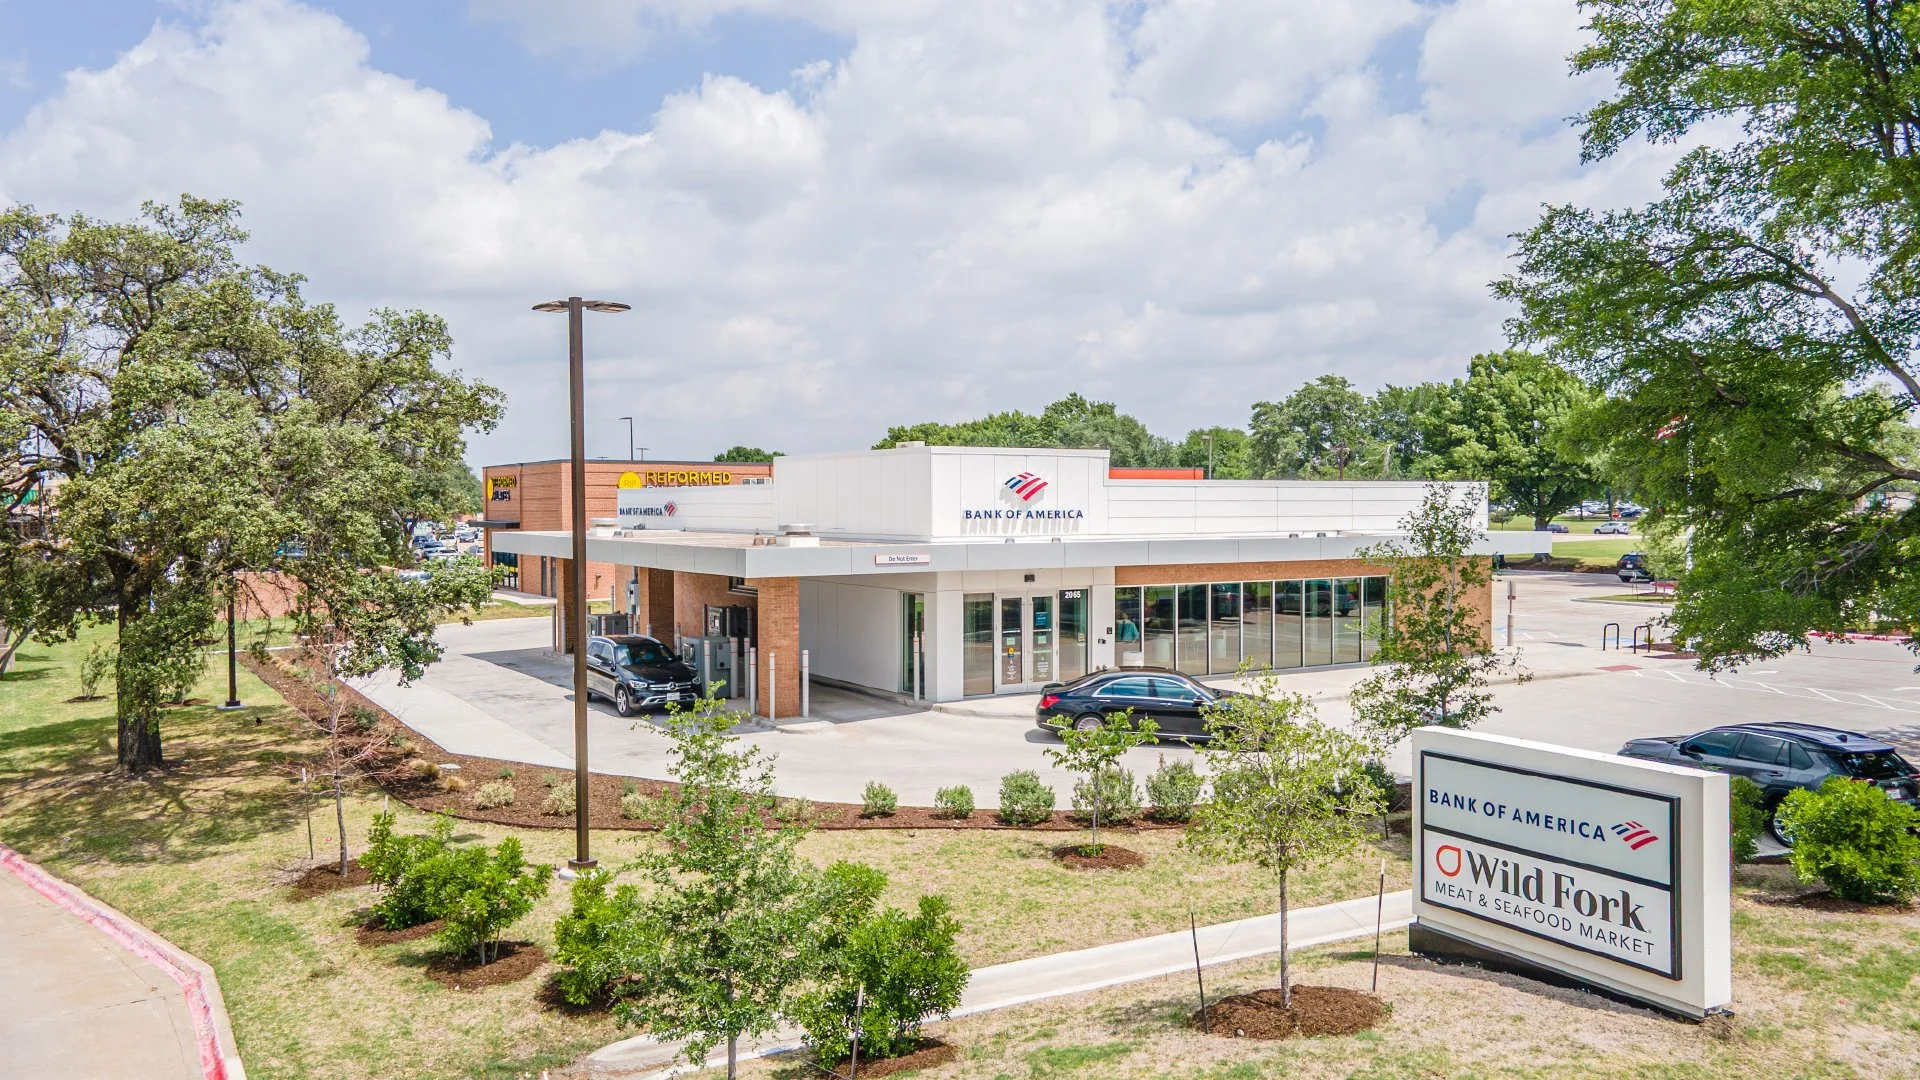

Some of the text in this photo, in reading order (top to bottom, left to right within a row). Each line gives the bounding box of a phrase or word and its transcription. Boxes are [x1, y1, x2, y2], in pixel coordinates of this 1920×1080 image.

[645, 471, 732, 485] REFORMED
[619, 507, 633, 516] BANK
[639, 507, 663, 516] AMERICA
[965, 509, 1084, 519] BANK OF AMERICA
[1064, 591, 1081, 599] 2065
[1429, 789, 1606, 842] BANK OF AMERICA
[1465, 850, 1649, 933] Wild Fork
[1435, 880, 1655, 956] MEAT & SEAFOOD MARKET
